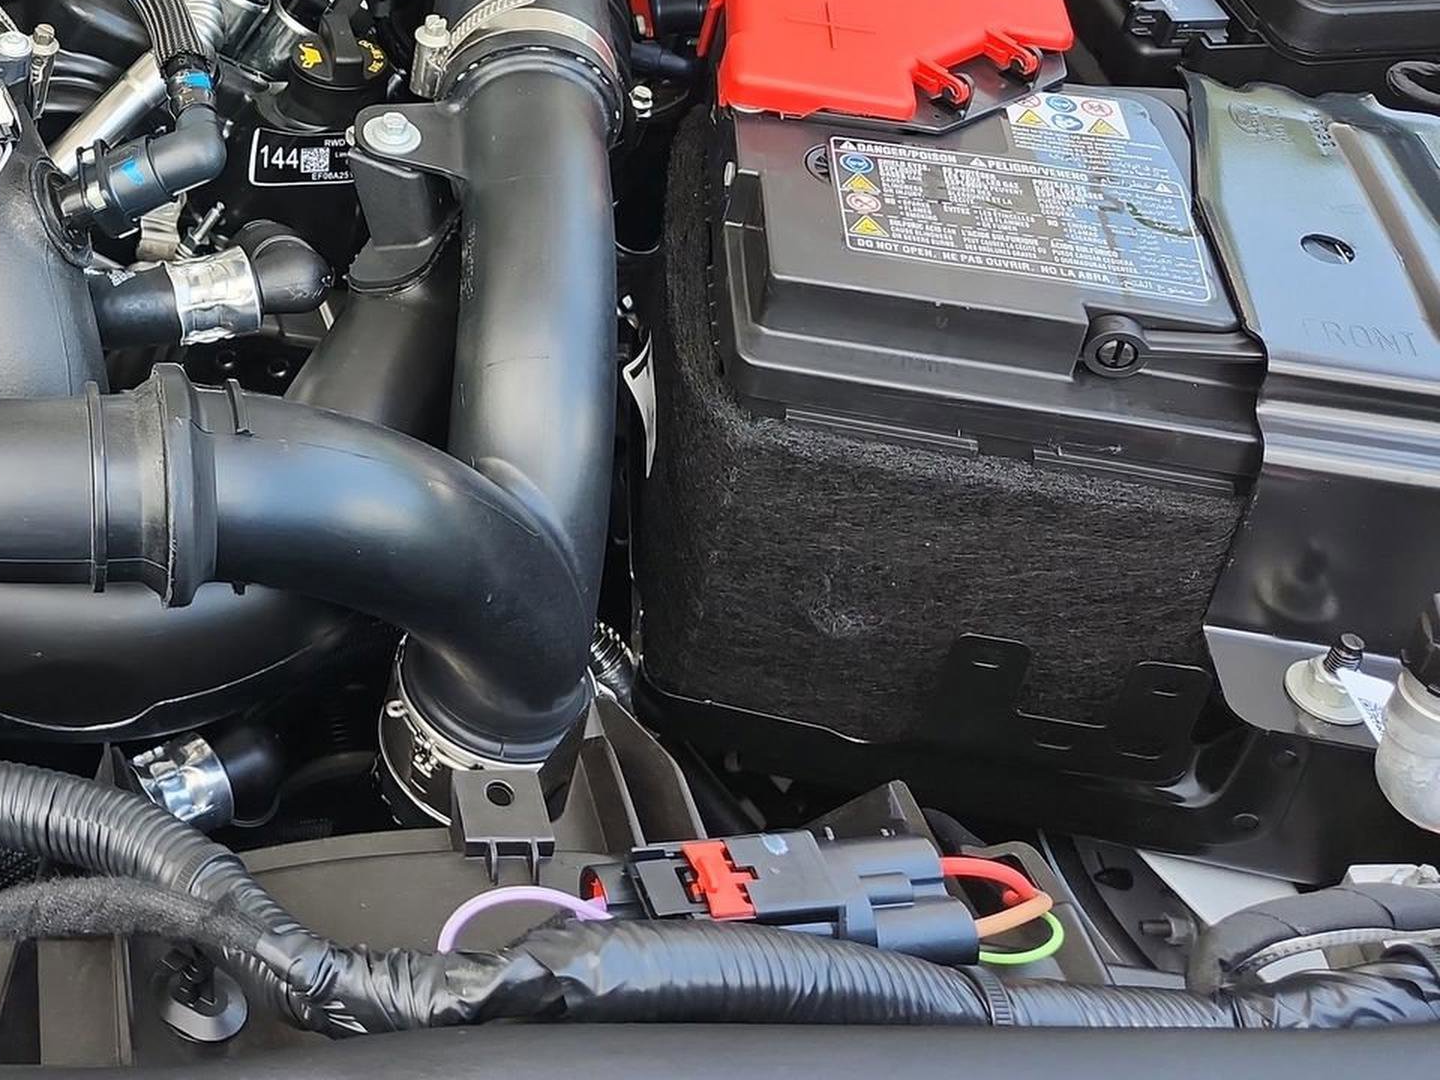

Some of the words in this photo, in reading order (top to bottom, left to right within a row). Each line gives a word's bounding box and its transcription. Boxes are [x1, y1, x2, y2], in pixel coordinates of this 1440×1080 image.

[260, 145, 299, 169] 144
[324, 139, 346, 147] RWD
[857, 142, 957, 163] DANGER/POISON
[986, 160, 1088, 182] PELIGRO/VENENO
[857, 238, 874, 249] DO
[876, 241, 900, 253] NOT
[943, 251, 958, 261] NE
[960, 253, 984, 265] PAS
[987, 257, 1035, 272] OUVRIR.
[1040, 264, 1057, 275] NO
[1060, 267, 1076, 278] LA
